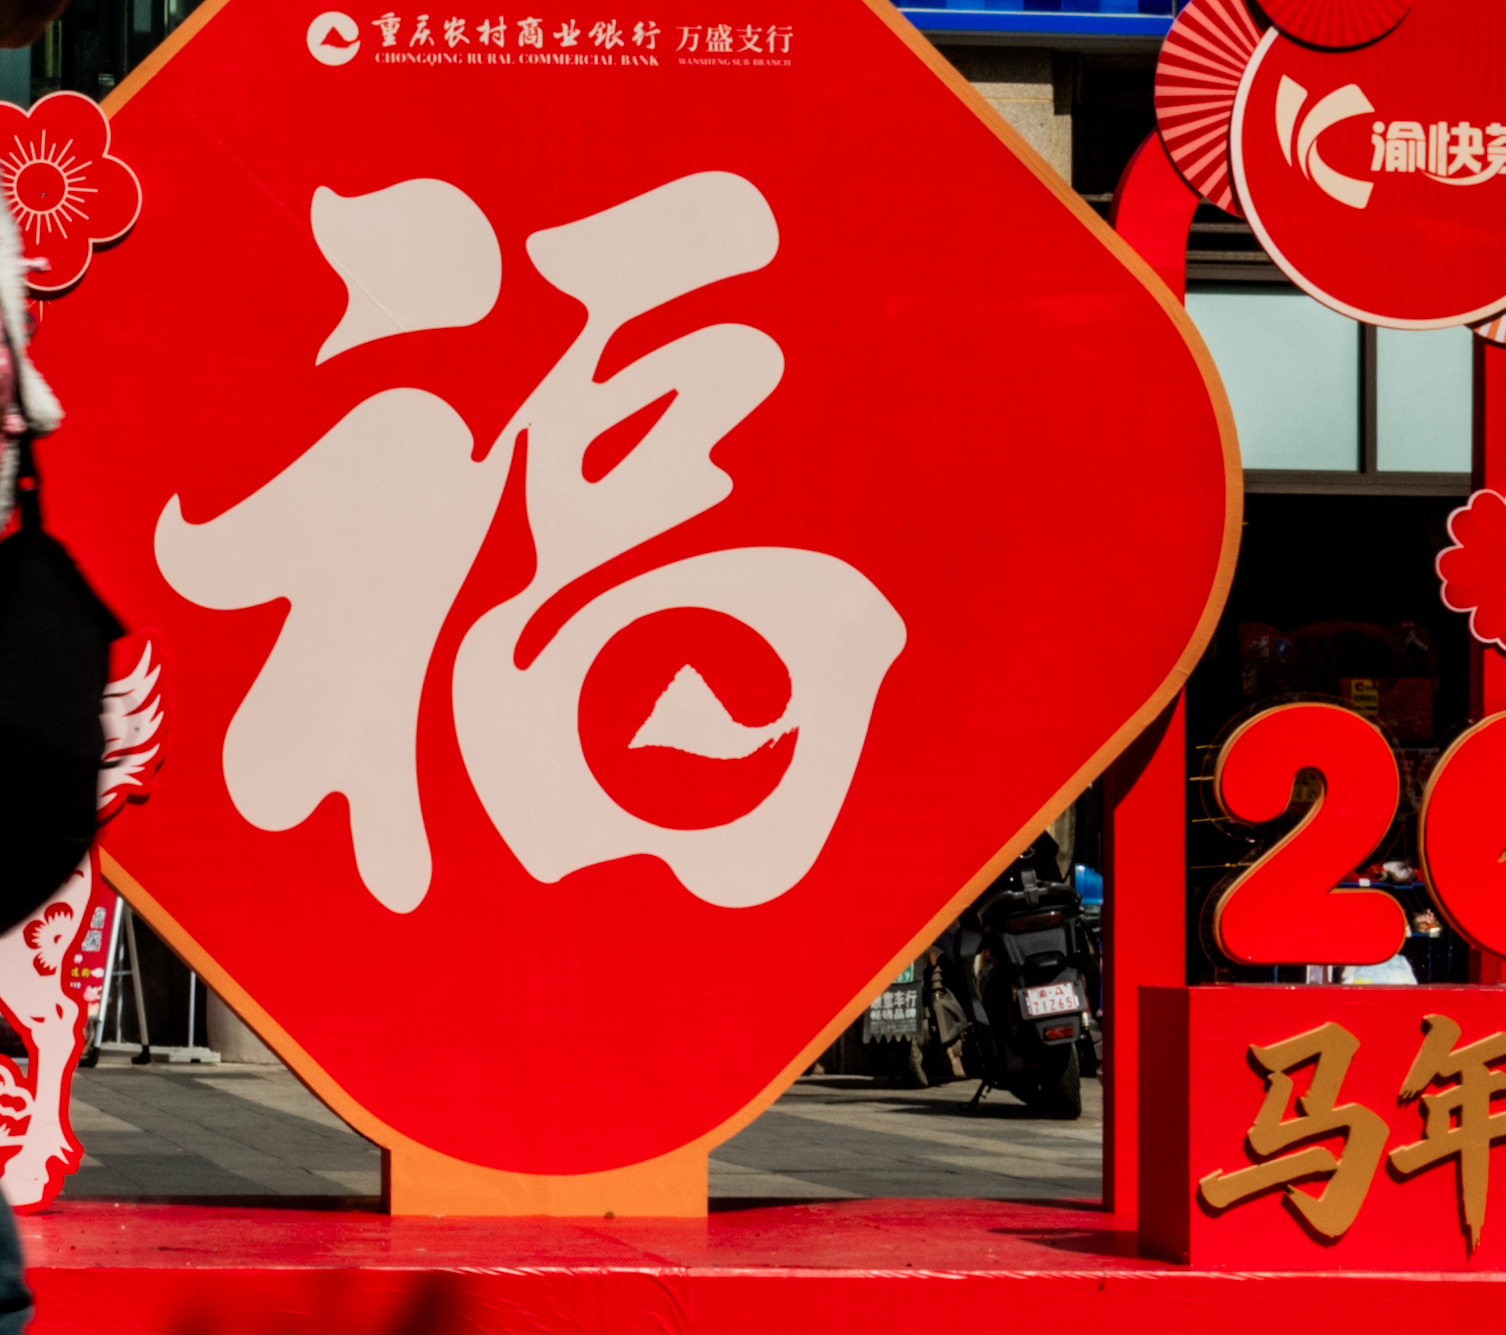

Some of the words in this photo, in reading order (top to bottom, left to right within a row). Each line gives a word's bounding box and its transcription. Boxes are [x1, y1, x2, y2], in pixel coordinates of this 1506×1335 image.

[675, 24, 794, 53] 万盛支行
[374, 52, 463, 66] CHONGQING
[468, 52, 515, 65] RURAL
[518, 53, 617, 66] COMMERCIAL
[621, 54, 659, 66] BANK
[153, 169, 908, 914] 福
